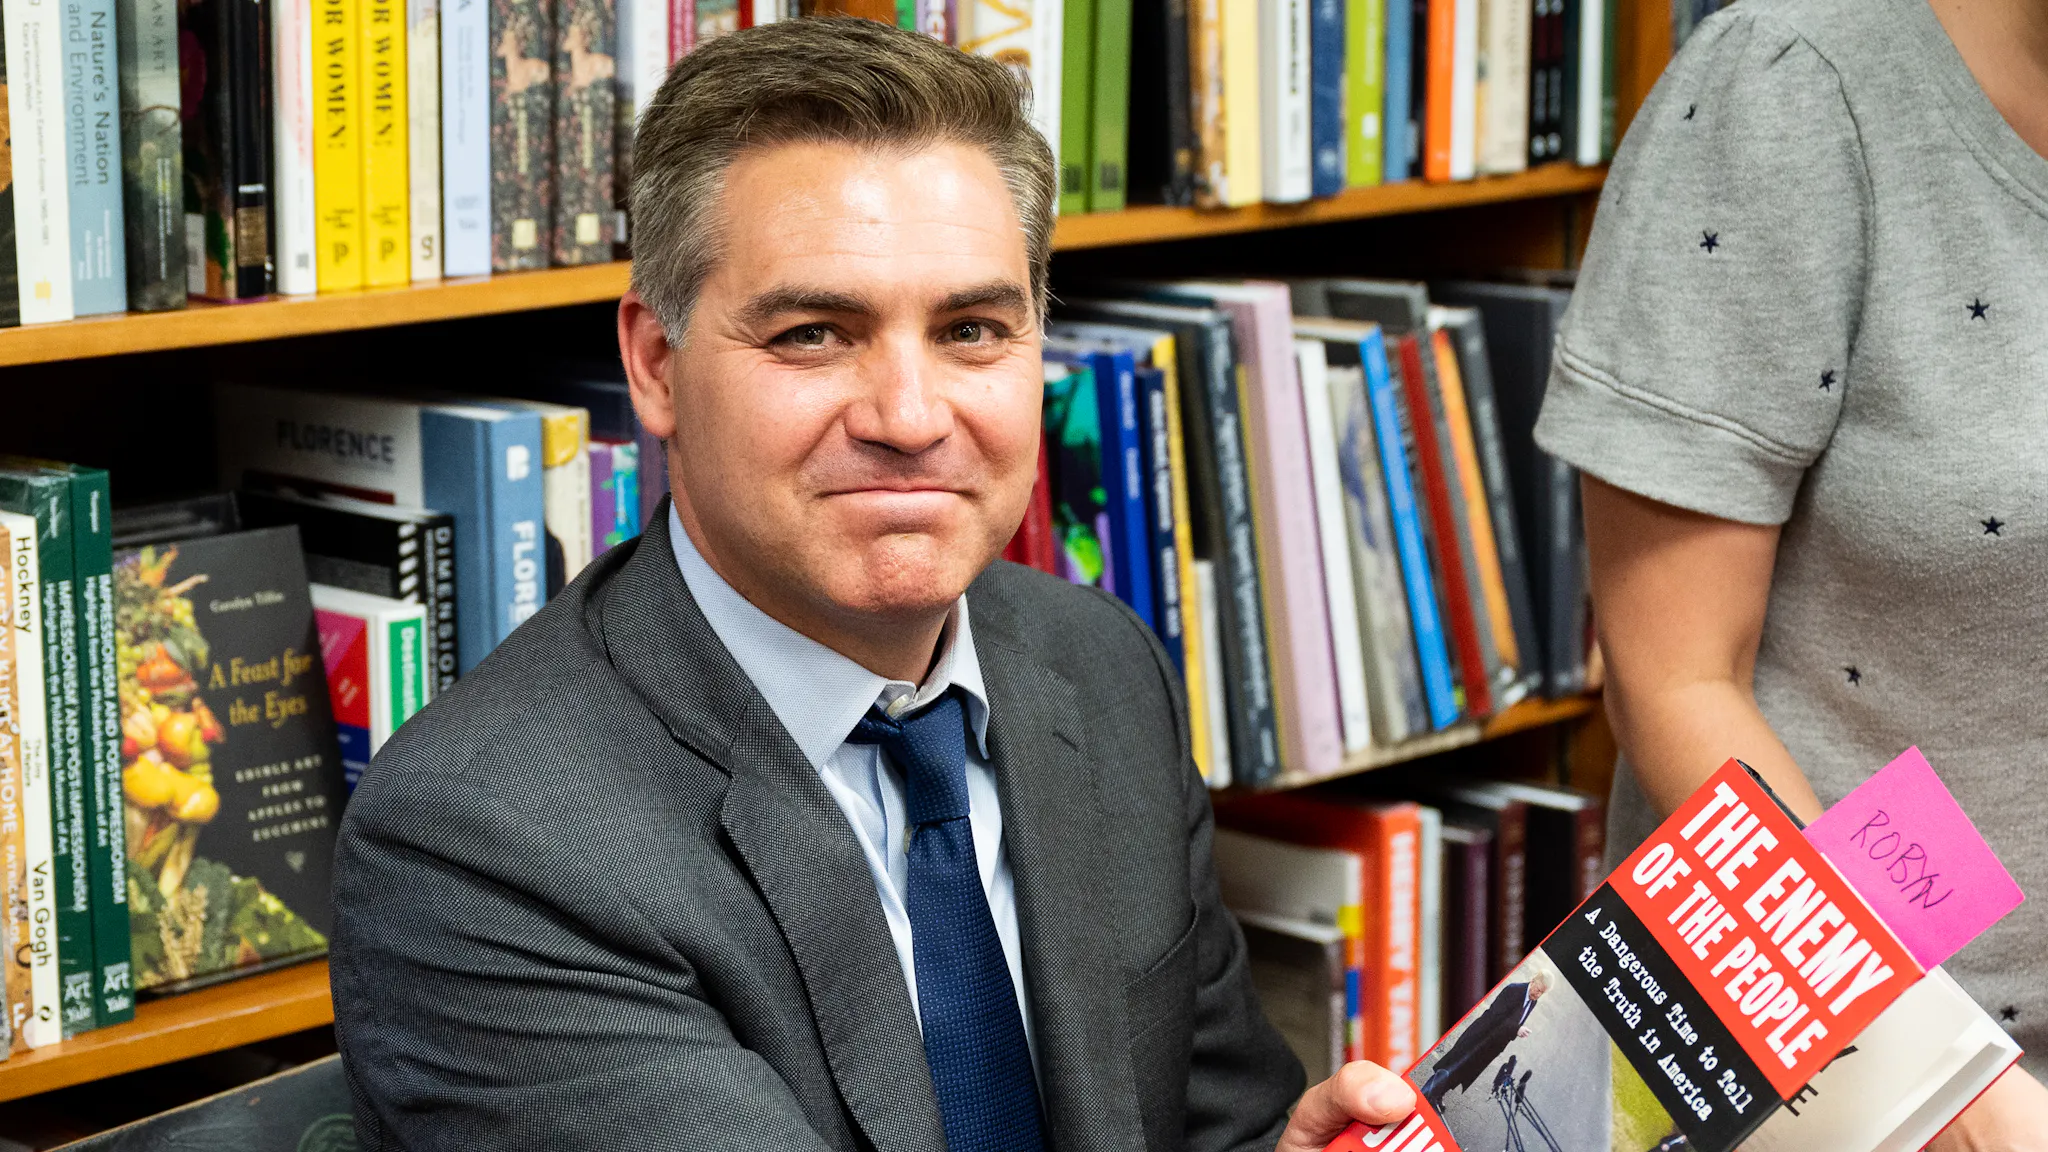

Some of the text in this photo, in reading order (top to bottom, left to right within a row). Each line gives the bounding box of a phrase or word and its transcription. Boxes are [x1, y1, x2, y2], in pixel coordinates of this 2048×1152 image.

[152, 38, 167, 73] ART
[67, 4, 89, 187] and Environment
[89, 10, 110, 186] Nature's Nation
[277, 421, 395, 466] FLORENCE
[14, 536, 33, 634] Hockney
[86, 576, 99, 637] Highlights
[44, 582, 58, 644] Highlights
[100, 574, 118, 697] IMPRESSIONISM
[47, 645, 59, 674] from
[58, 580, 78, 705] IMPRESSIONISM
[88, 638, 100, 666] from
[209, 647, 313, 690] A Feast for
[50, 696, 64, 769] Philadelphia
[64, 707, 79, 743] AND
[90, 688, 104, 761] Philadelphia
[105, 699, 119, 735] AND
[229, 696, 258, 726] the
[265, 690, 307, 729] Eyes
[0, 732, 14, 761] AT
[24, 752, 32, 787] Nature
[235, 761, 292, 783] EDIBLE
[294, 755, 324, 775] ART
[1, 766, 17, 833] HOME
[53, 770, 65, 820] Museum
[94, 762, 105, 812] Museum
[248, 795, 327, 821] APPLES TO
[262, 780, 304, 797] FROM
[1849, 808, 1954, 910] ROBYN
[32, 860, 52, 968] Van Gogh
[1679, 780, 1895, 1016] THE ENEMY
[1632, 842, 1692, 899] OF
[1667, 879, 1739, 961] THE
[1710, 936, 1829, 1070] PEOPLE
[64, 981, 91, 1003] Art
[103, 972, 130, 995] Art
[1577, 945, 1714, 1123] the Truth in America
[1584, 907, 1755, 1116] A Dangerous Time to Tell
